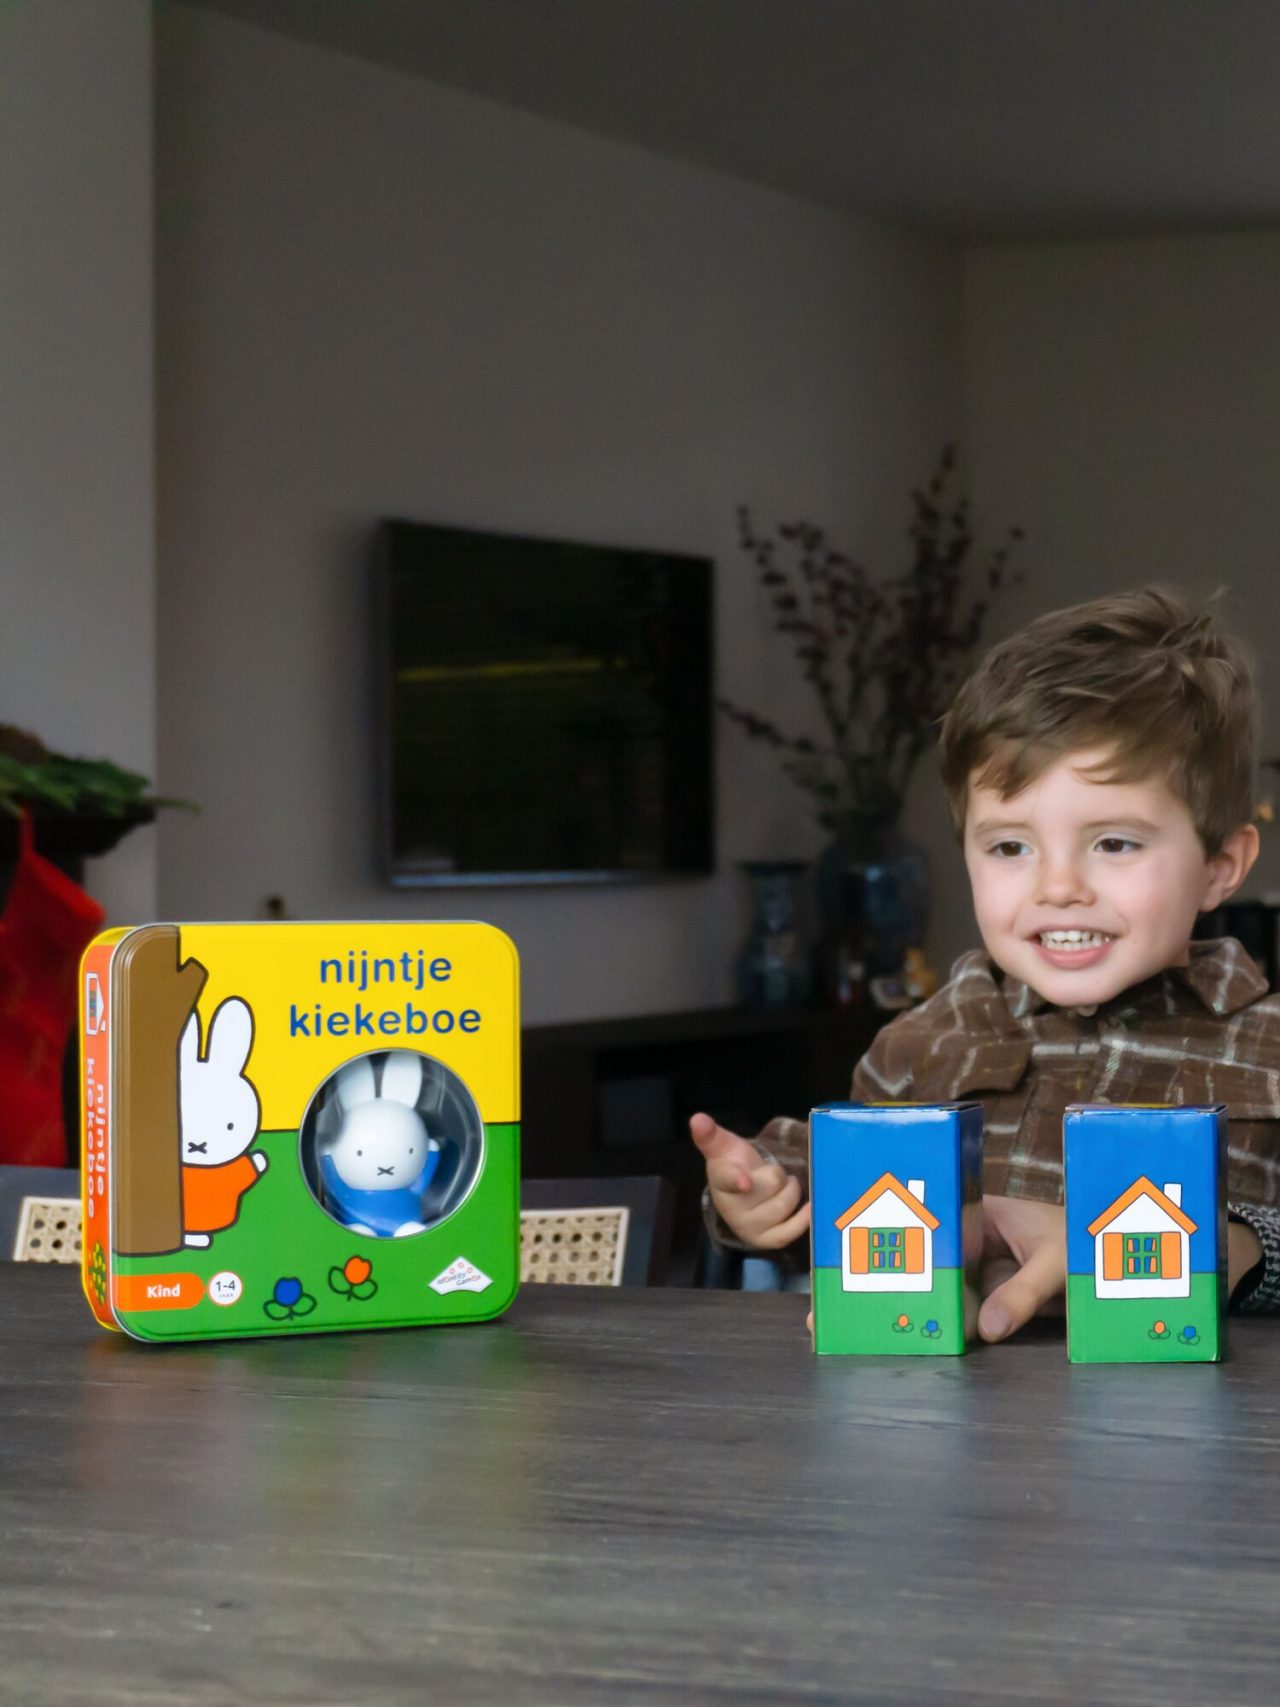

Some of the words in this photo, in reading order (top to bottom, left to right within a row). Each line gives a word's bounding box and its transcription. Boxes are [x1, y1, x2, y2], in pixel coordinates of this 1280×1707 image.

[320, 949, 453, 991] nijntje
[290, 1002, 482, 1037] kiekeboe
[87, 1058, 95, 1218] kiekeboe
[147, 1283, 181, 1299] Kind
[215, 1280, 236, 1292] 1-4
